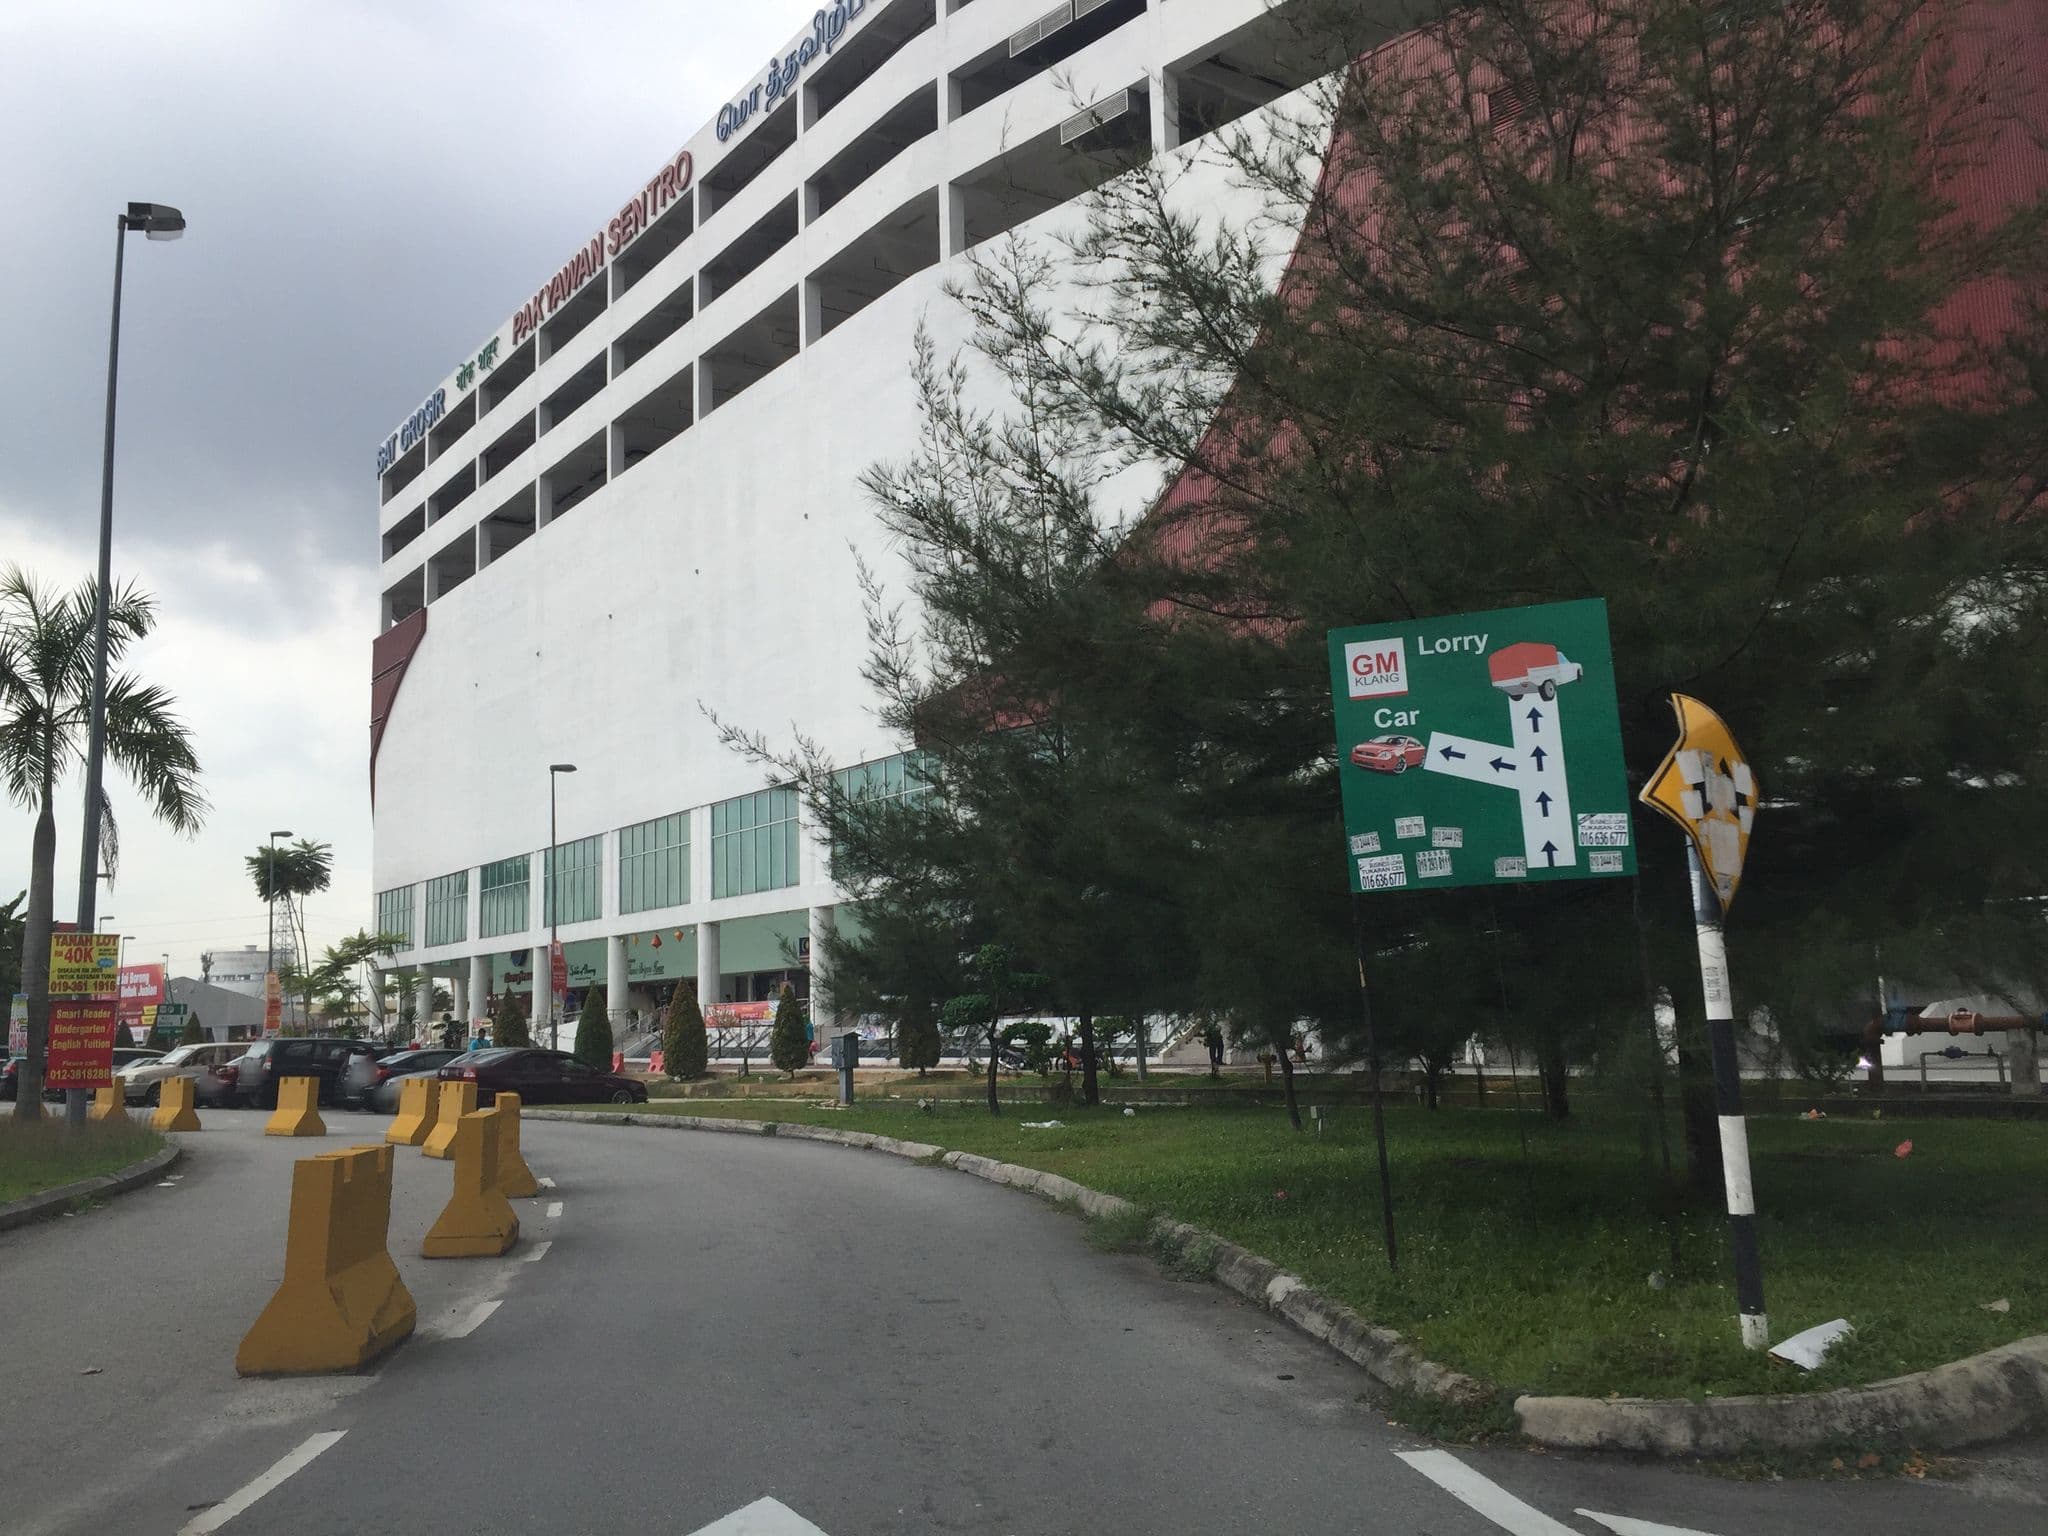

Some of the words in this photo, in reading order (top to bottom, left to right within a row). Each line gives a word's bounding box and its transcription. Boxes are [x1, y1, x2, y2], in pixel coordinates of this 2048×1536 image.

[607, 150, 693, 256] SENTRO
[400, 388, 446, 453] GROSIR
[1417, 633, 1489, 656] Lorry
[1352, 651, 1399, 676] GM
[1355, 673, 1400, 687] KLANG
[1374, 708, 1420, 728] Car
[1581, 832, 1593, 845] 016
[1609, 831, 1628, 845] 6777
[1362, 874, 1375, 889] 016
[1389, 872, 1405, 886] 6777
[54, 935, 93, 947] TANAH
[64, 946, 94, 963] 40K
[56, 1009, 80, 1019] Smart
[83, 1009, 111, 1019] Reader
[54, 1024, 106, 1035] Kindergarten
[52, 1039, 81, 1051] English
[84, 1039, 111, 1049] Tuition
